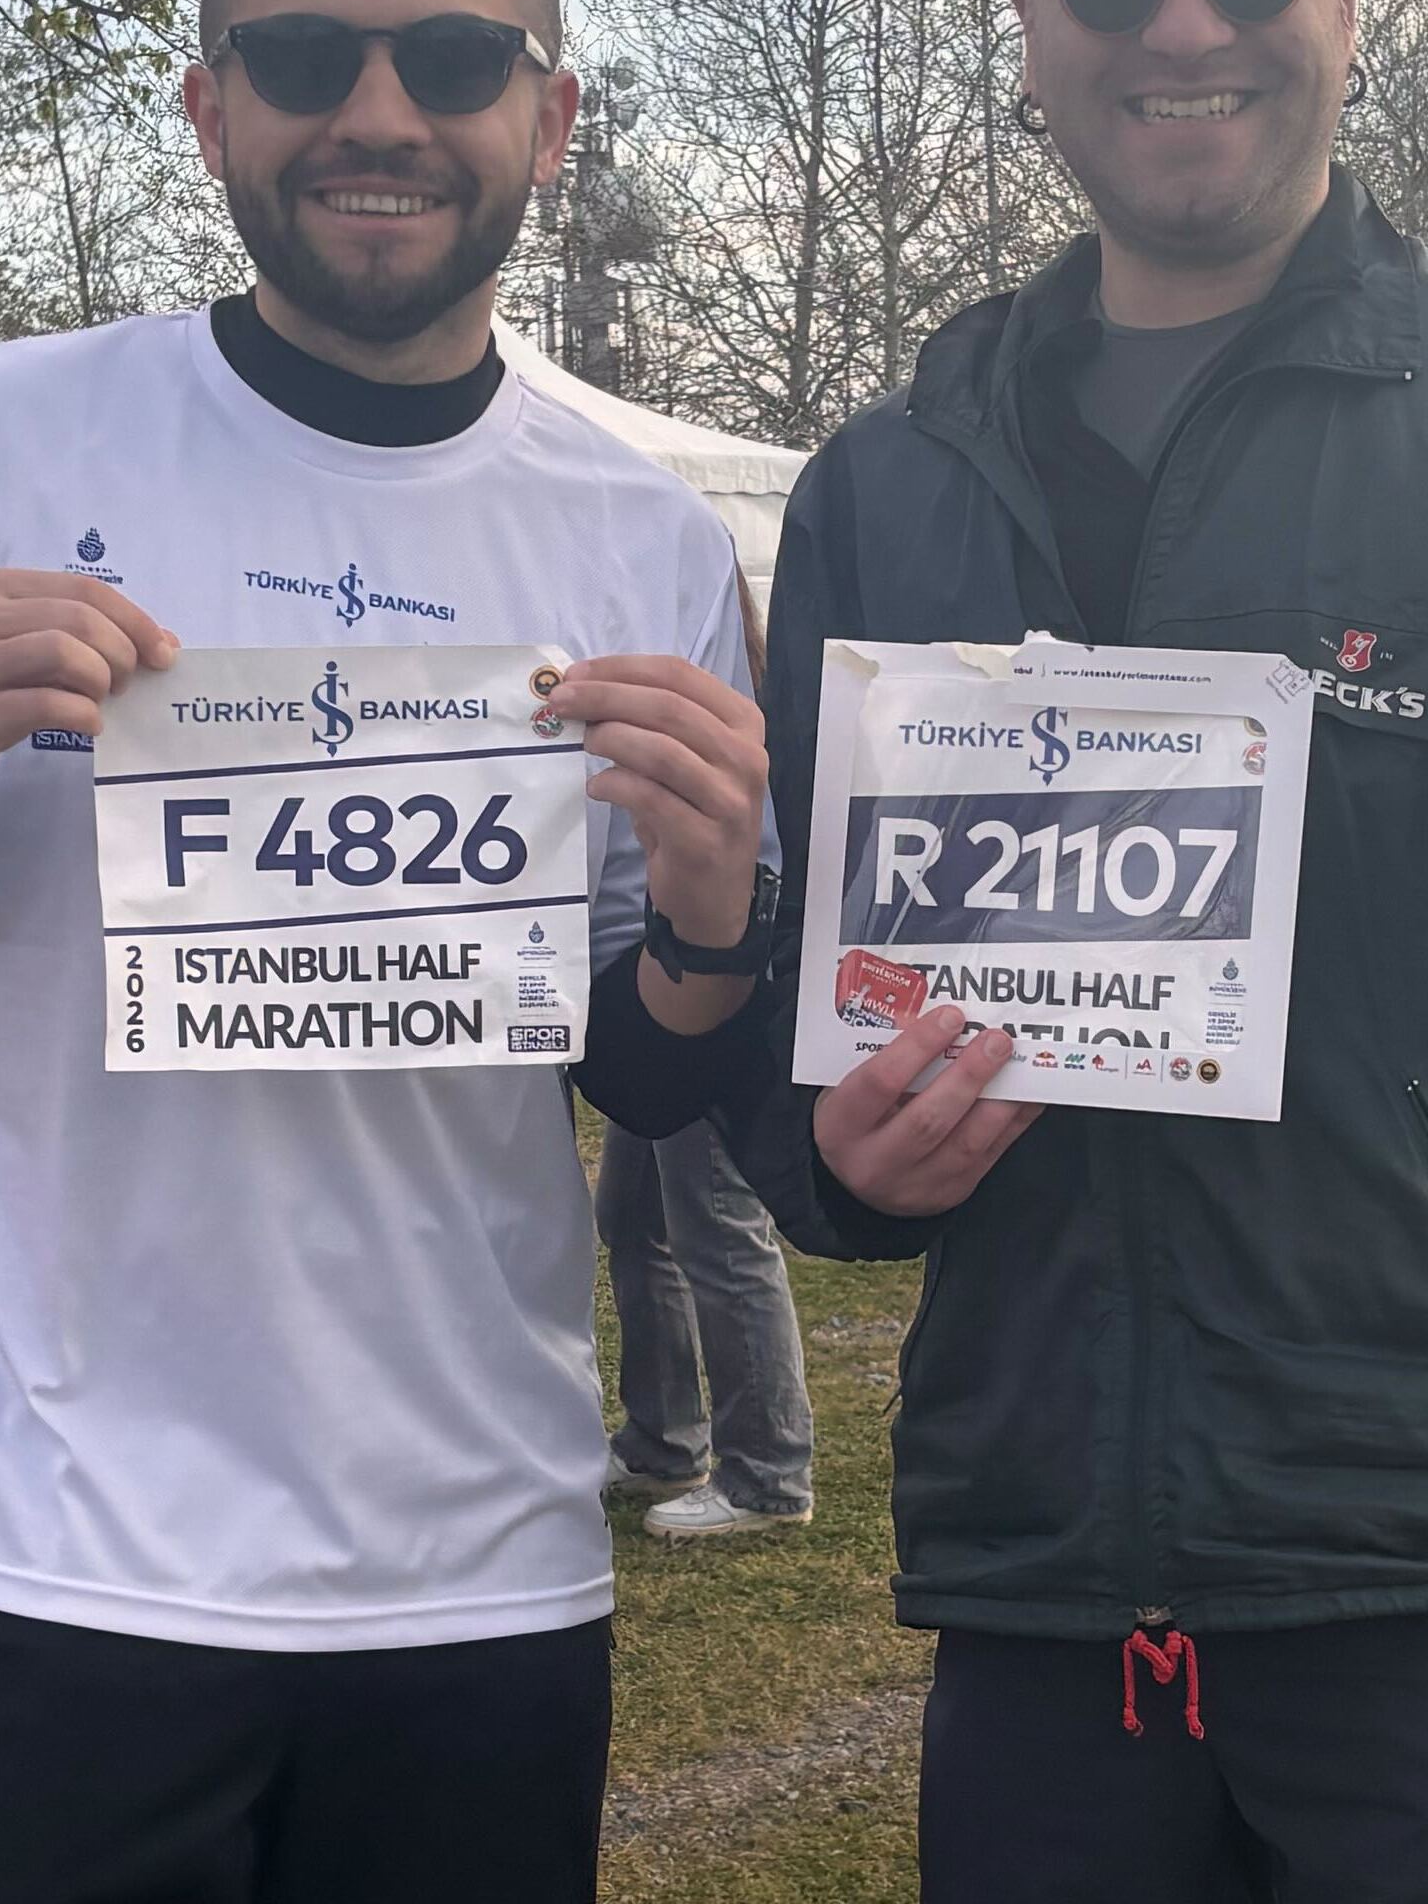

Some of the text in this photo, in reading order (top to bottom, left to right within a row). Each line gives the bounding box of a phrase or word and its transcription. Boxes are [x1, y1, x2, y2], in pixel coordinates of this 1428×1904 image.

[244, 570, 334, 600] TÜRKİYE
[369, 593, 456, 623] BANKASI
[172, 696, 305, 723] TÜRKİYE
[360, 698, 488, 721] BANKASI
[1311, 668, 1426, 719] ECK'S
[899, 720, 1024, 749] TÜRKİYE
[1076, 730, 1202, 754] BANKASI
[164, 794, 527, 887] F 4826
[875, 817, 1238, 918] R 21107
[174, 944, 481, 984] ISTANBUL HALF
[125, 945, 145, 1053] 2026
[1073, 971, 1175, 1010] HALF
[177, 999, 483, 1049] MARATHON
[511, 1028, 565, 1041] SPOR
